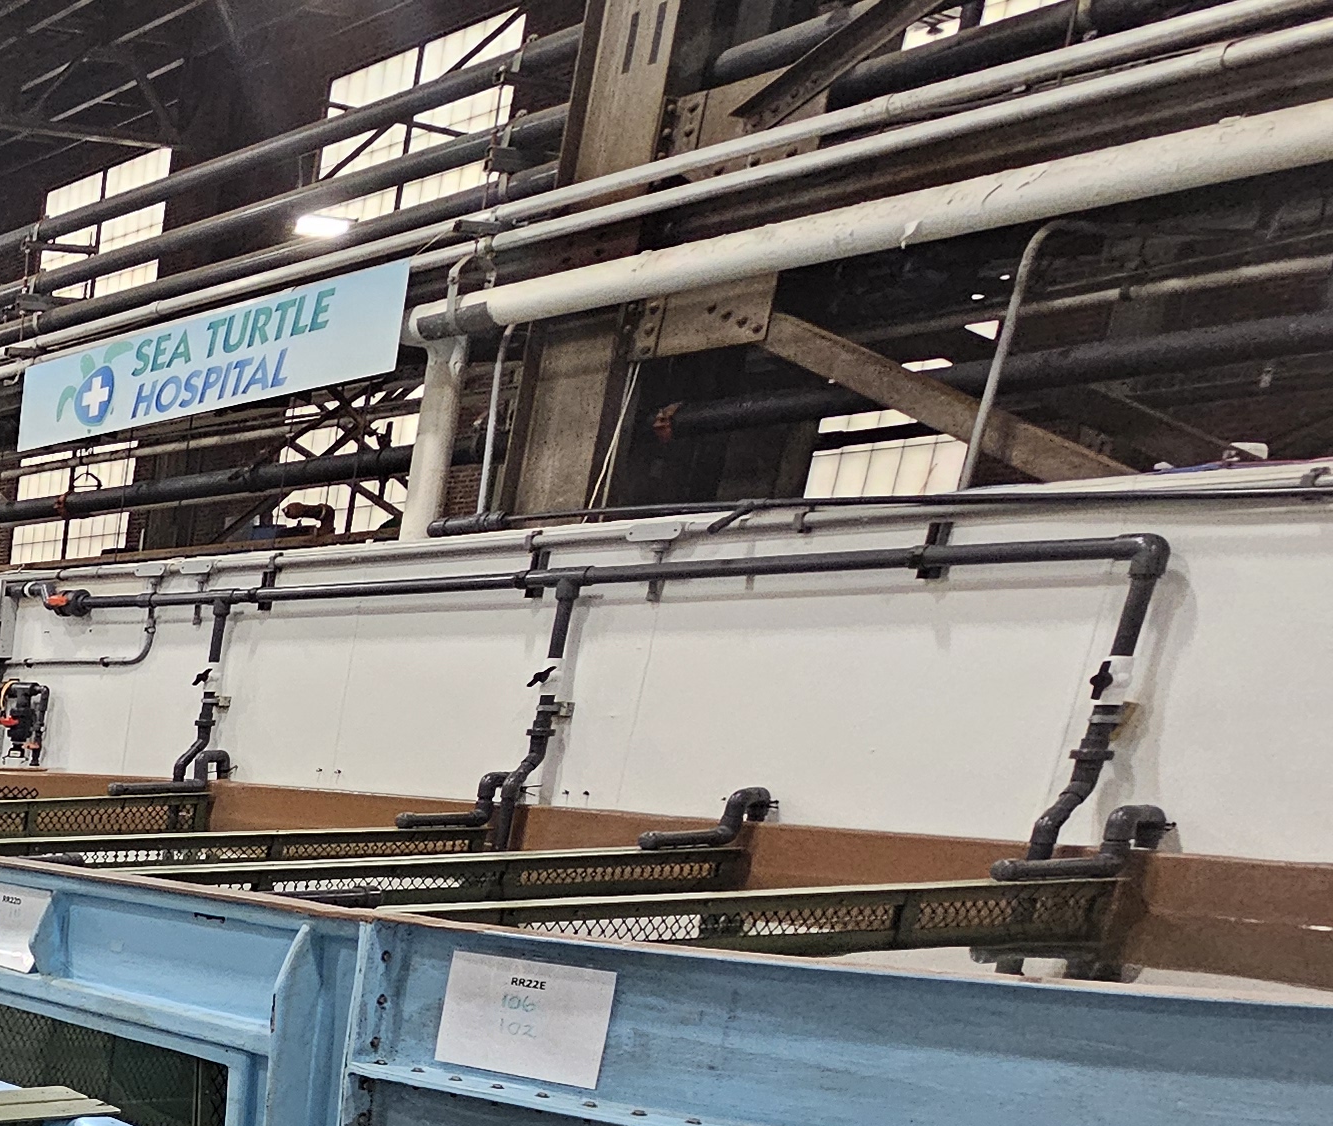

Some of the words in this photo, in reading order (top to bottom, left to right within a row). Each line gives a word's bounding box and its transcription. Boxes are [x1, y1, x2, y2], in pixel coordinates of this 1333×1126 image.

[131, 328, 192, 377] SEA
[206, 287, 336, 358] TURTLE
[130, 347, 289, 420] HOSPITAL
[510, 976, 547, 991] RR22E
[500, 992, 538, 1013] 106
[499, 1016, 538, 1038] 102
